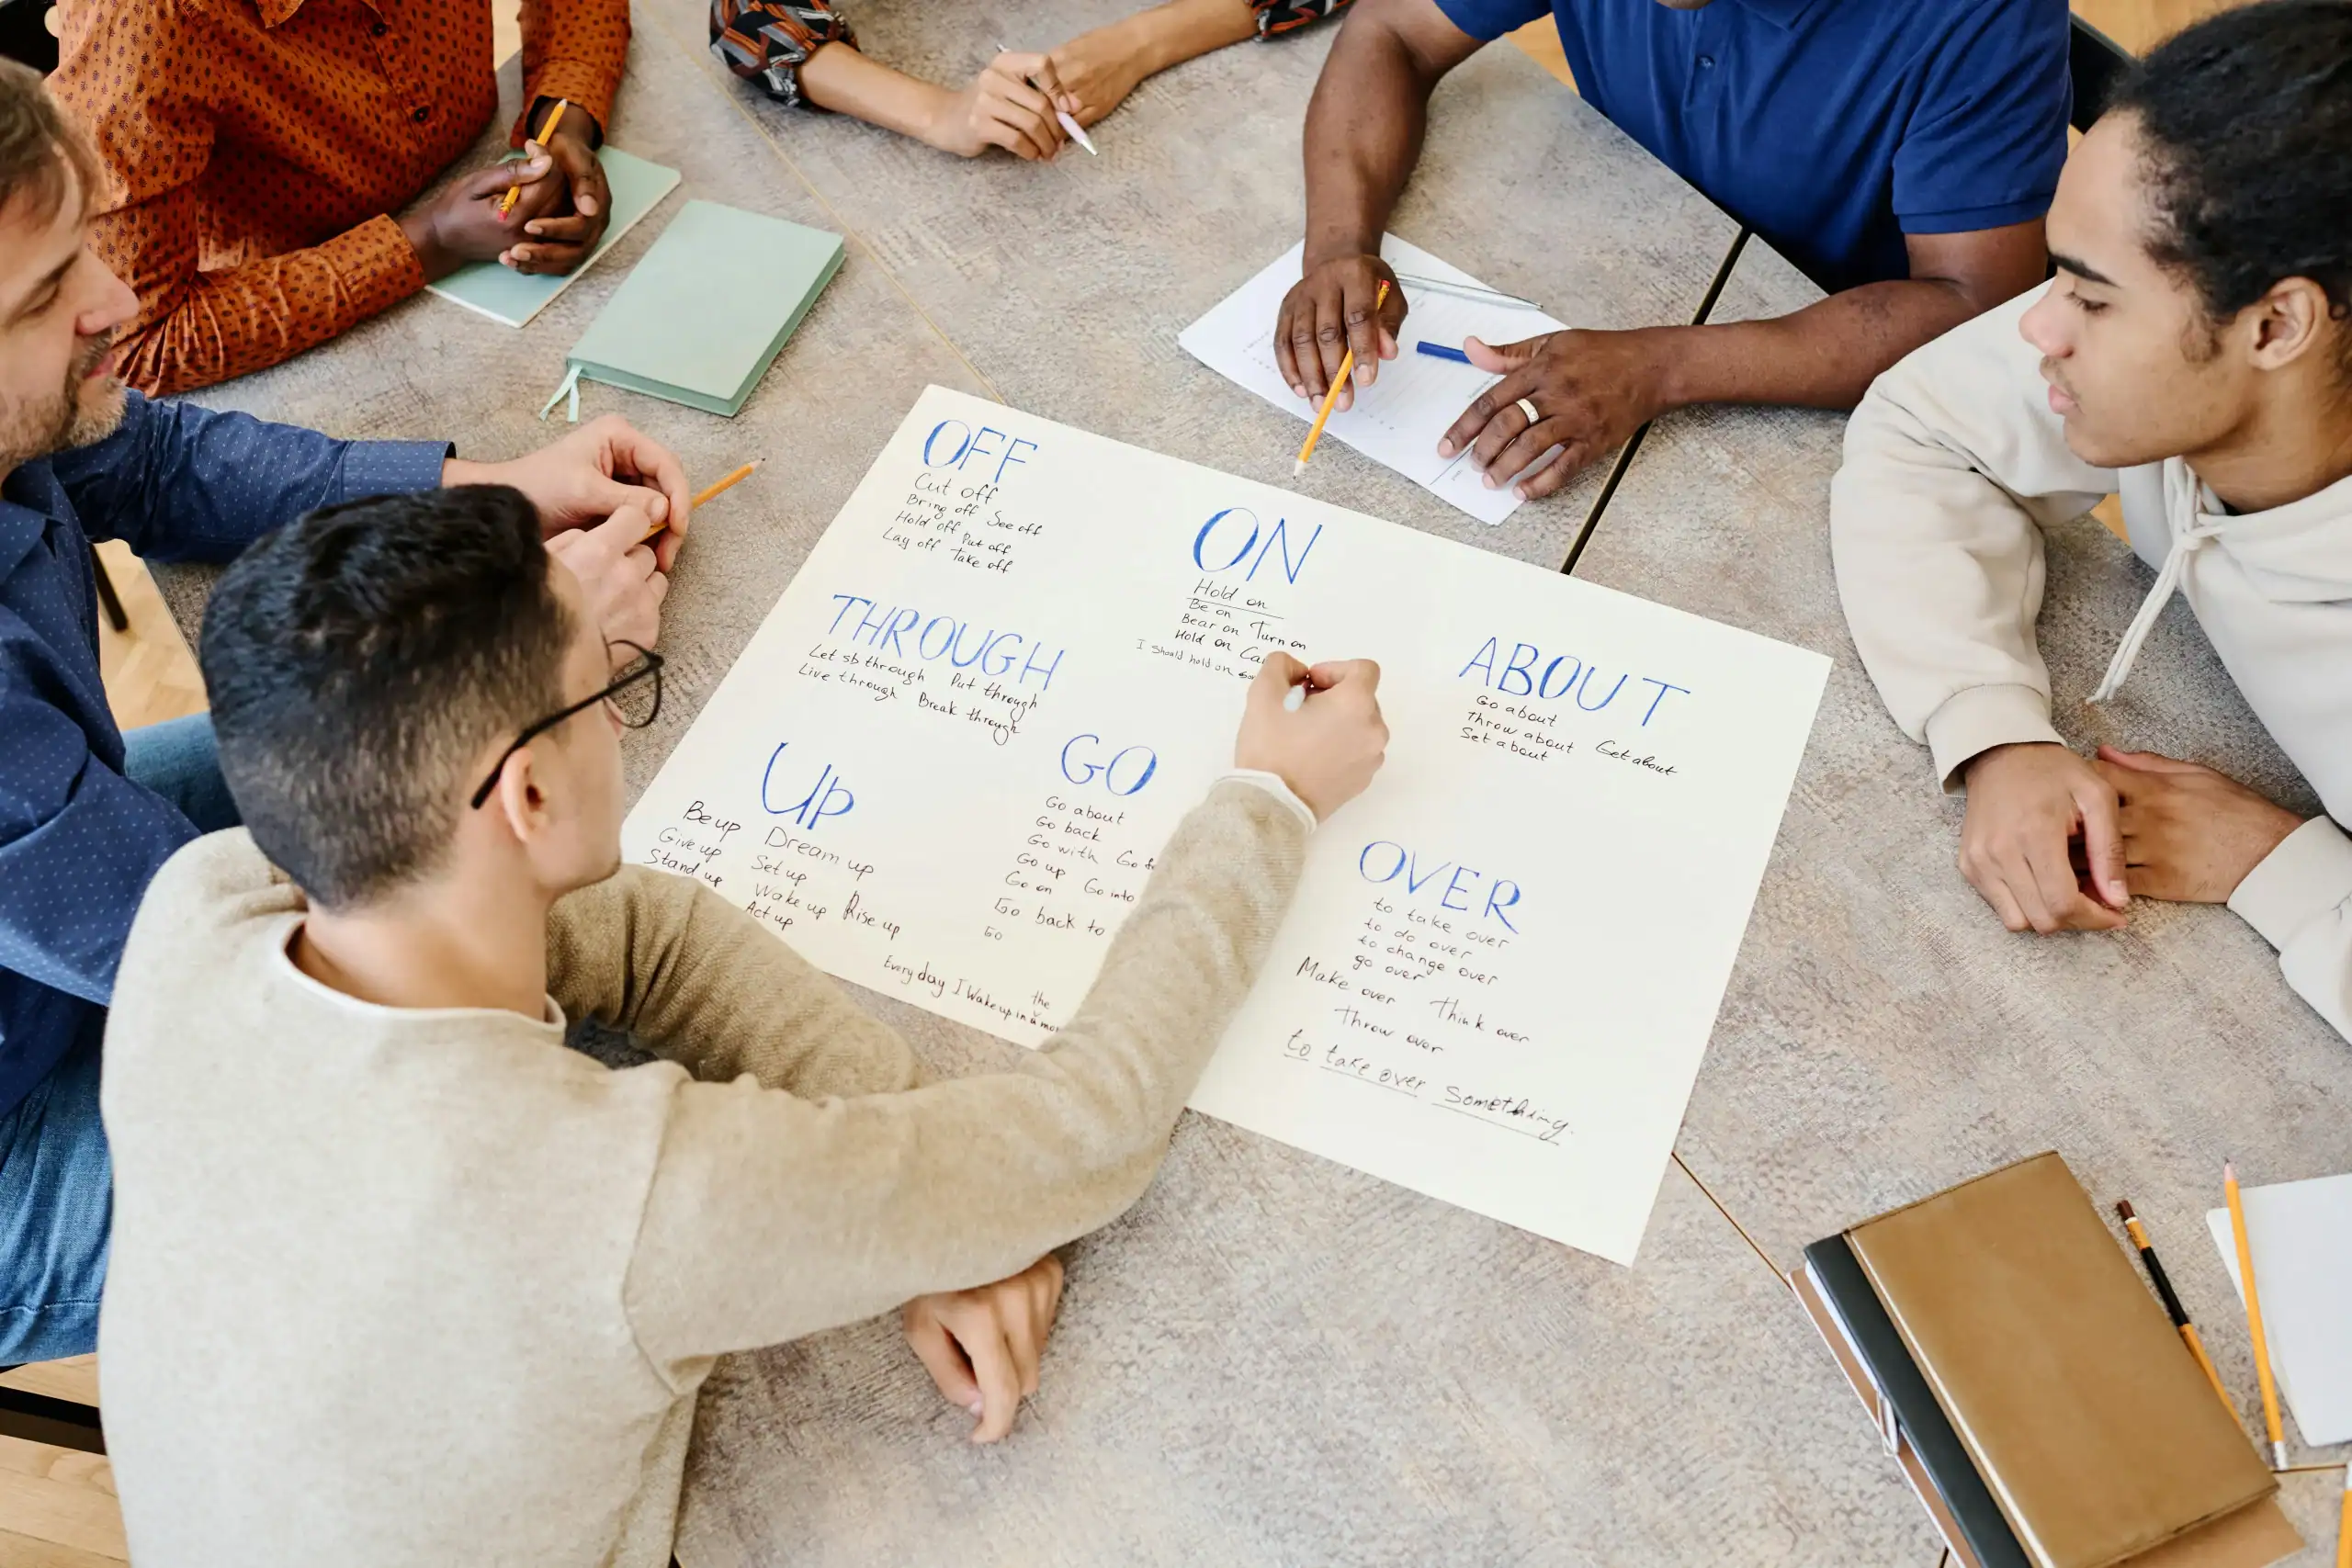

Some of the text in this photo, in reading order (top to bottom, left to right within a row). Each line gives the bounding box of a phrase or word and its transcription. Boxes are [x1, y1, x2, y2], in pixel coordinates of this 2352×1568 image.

[923, 420, 1037, 483] OFF
[914, 473, 999, 503] Cut off
[896, 511, 1012, 555] Hold off Put off
[906, 494, 1043, 536] Bring off See off
[883, 527, 910, 549] Lay
[917, 538, 941, 551] off
[988, 560, 1012, 573] off
[1193, 507, 1322, 584] ON
[1189, 598, 1231, 618] Be on
[1193, 579, 1268, 609] Hold on
[829, 594, 1064, 691] THROUGH
[1175, 629, 1203, 645] Hold
[1215, 638, 1232, 651] on
[1182, 614, 1306, 649] Bear on Turn on
[808, 644, 837, 660] Let
[865, 656, 925, 685] through
[950, 673, 976, 690] Put
[984, 682, 1037, 722] through
[1189, 654, 1211, 668] hold
[1215, 663, 1234, 676] on
[1459, 637, 1690, 727] ABOUT
[798, 663, 1021, 745] Live through Break through
[1476, 695, 1557, 727] Go about
[1461, 727, 1549, 761] Set about
[1524, 729, 1575, 753] about
[1595, 740, 1678, 776] Get about
[1061, 734, 1157, 795] GO
[683, 801, 741, 842] Be up
[1036, 817, 1102, 842] Go back
[1046, 796, 1125, 825] Go about
[659, 827, 722, 863] Give up
[764, 827, 874, 881] Dream up
[1028, 834, 1049, 849] Go
[1058, 846, 1099, 864] with
[1116, 851, 1137, 868] Go
[643, 849, 723, 887] Stand up
[751, 855, 808, 886] Set up
[1017, 852, 1066, 879] Go up
[1005, 871, 1135, 902] Go on Go into
[1360, 840, 1521, 934] OVER
[746, 901, 794, 931] Act up
[756, 883, 900, 940] Wake up Rise up
[994, 897, 1104, 936] Go back to
[1374, 897, 1510, 949] to take over
[1364, 918, 1473, 959] to do over
[1352, 953, 1426, 981] go over
[1358, 935, 1498, 986] to change over
[884, 954, 913, 985] Every
[918, 962, 945, 998] day
[952, 978, 967, 995] I
[1000, 1007, 1012, 1021] up
[1016, 1011, 1027, 1021] in
[1031, 990, 1050, 1010] the
[1296, 956, 1530, 1043] Make over Think over
[1334, 1005, 1444, 1054] Throw over
[1286, 1029, 1311, 1057] to
[1327, 1044, 1371, 1076] take
[1379, 1069, 1426, 1089] over
